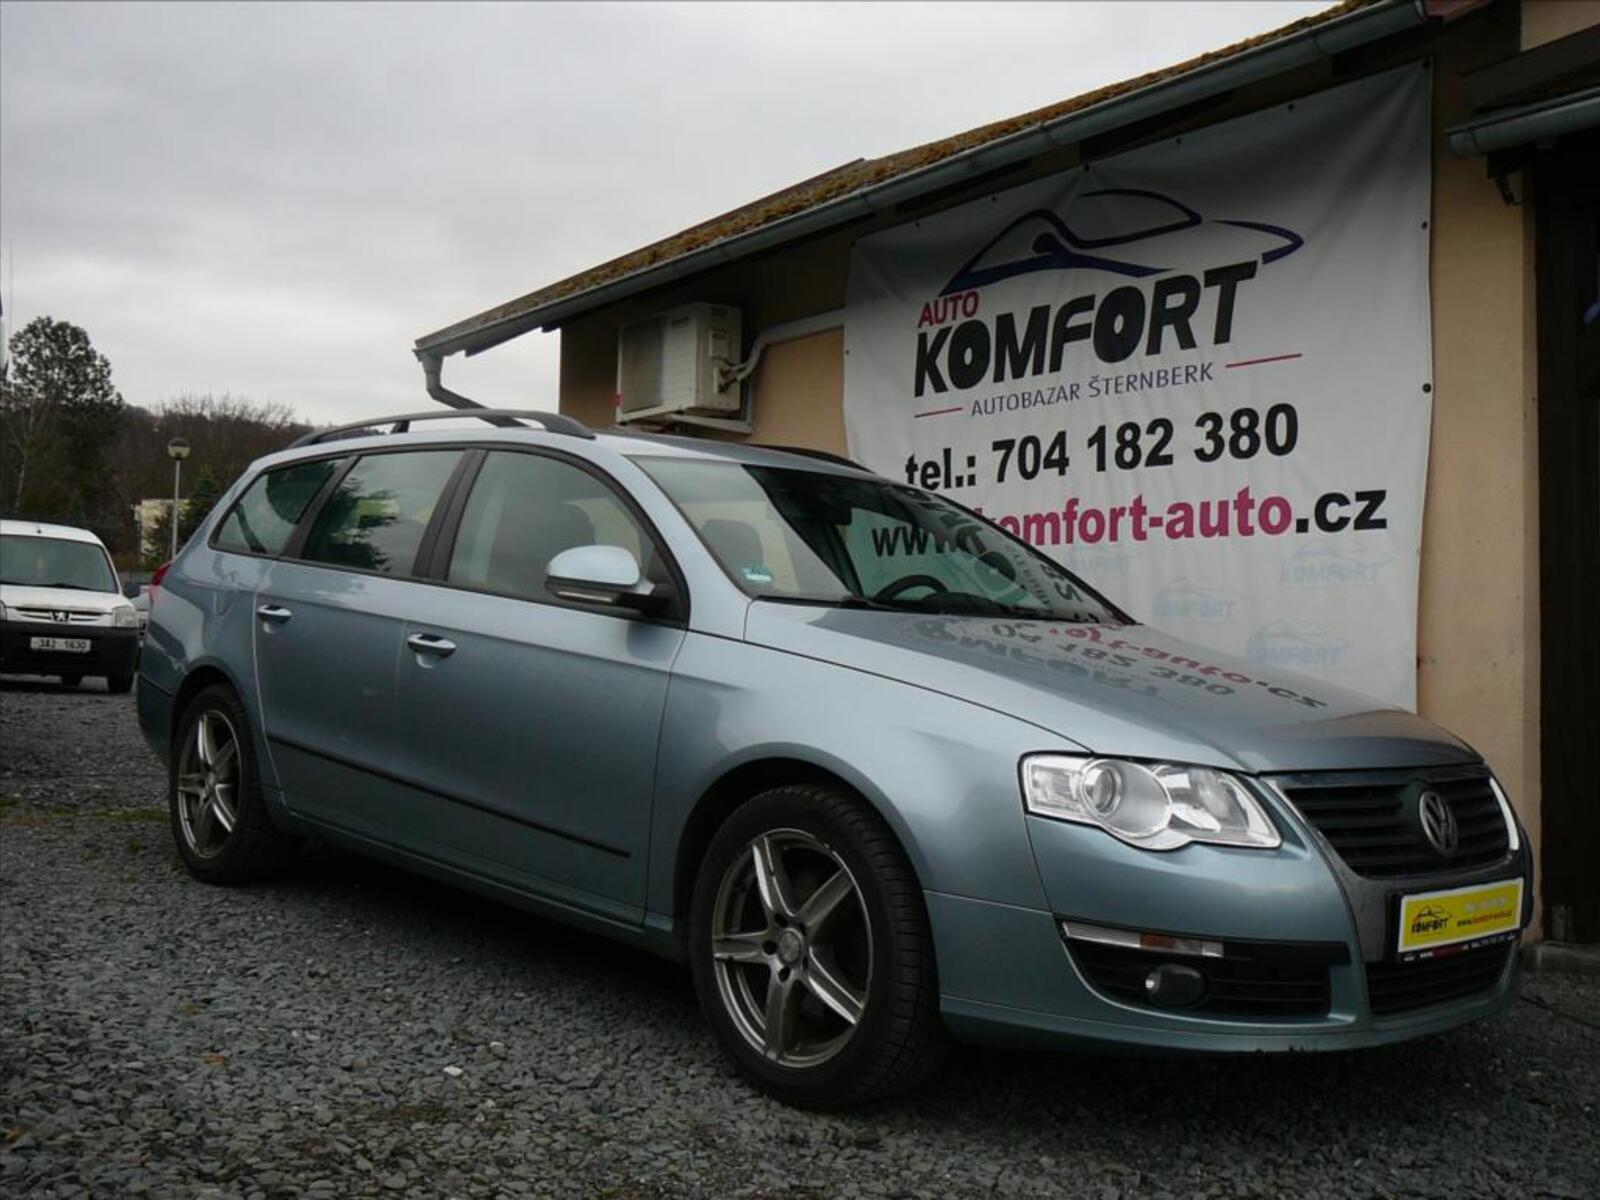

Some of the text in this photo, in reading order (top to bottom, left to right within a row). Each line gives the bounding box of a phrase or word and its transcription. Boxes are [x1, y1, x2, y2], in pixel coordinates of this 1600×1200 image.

[914, 261, 1257, 397] KOMFORT
[917, 290, 980, 328] AUTO
[971, 361, 1214, 417] AUTOBAZAR ŠTERNBERK
[905, 403, 1299, 490] tel.: 704 182 380
